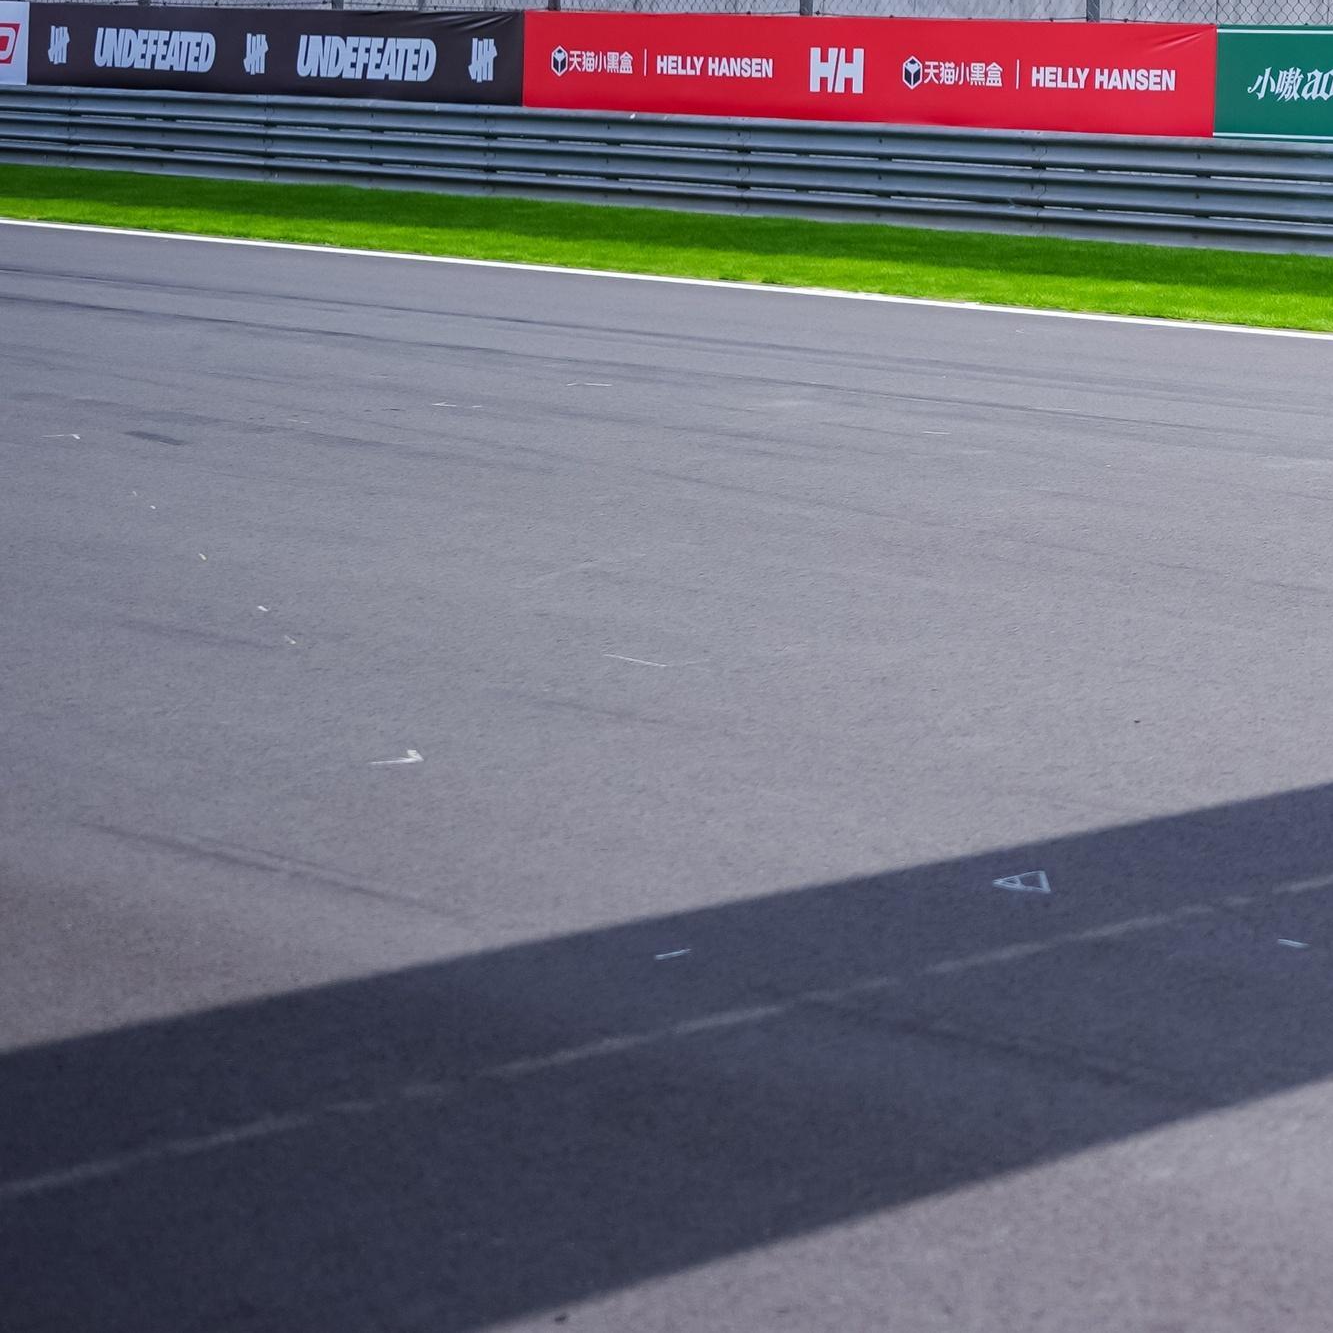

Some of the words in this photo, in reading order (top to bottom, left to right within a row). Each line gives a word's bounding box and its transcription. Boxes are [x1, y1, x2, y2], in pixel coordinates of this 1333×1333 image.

[94, 27, 217, 72] UNDEFEATED
[297, 34, 437, 83] UNDEFEATED
[569, 50, 634, 75] 天猫小黑盒
[656, 55, 704, 77] HELLY
[708, 57, 774, 79] HANSEN
[809, 47, 865, 94] HH
[924, 61, 1003, 88] 天猫小黑盒
[1031, 66, 1088, 90] HELLY
[1095, 68, 1176, 92] HANSEN
